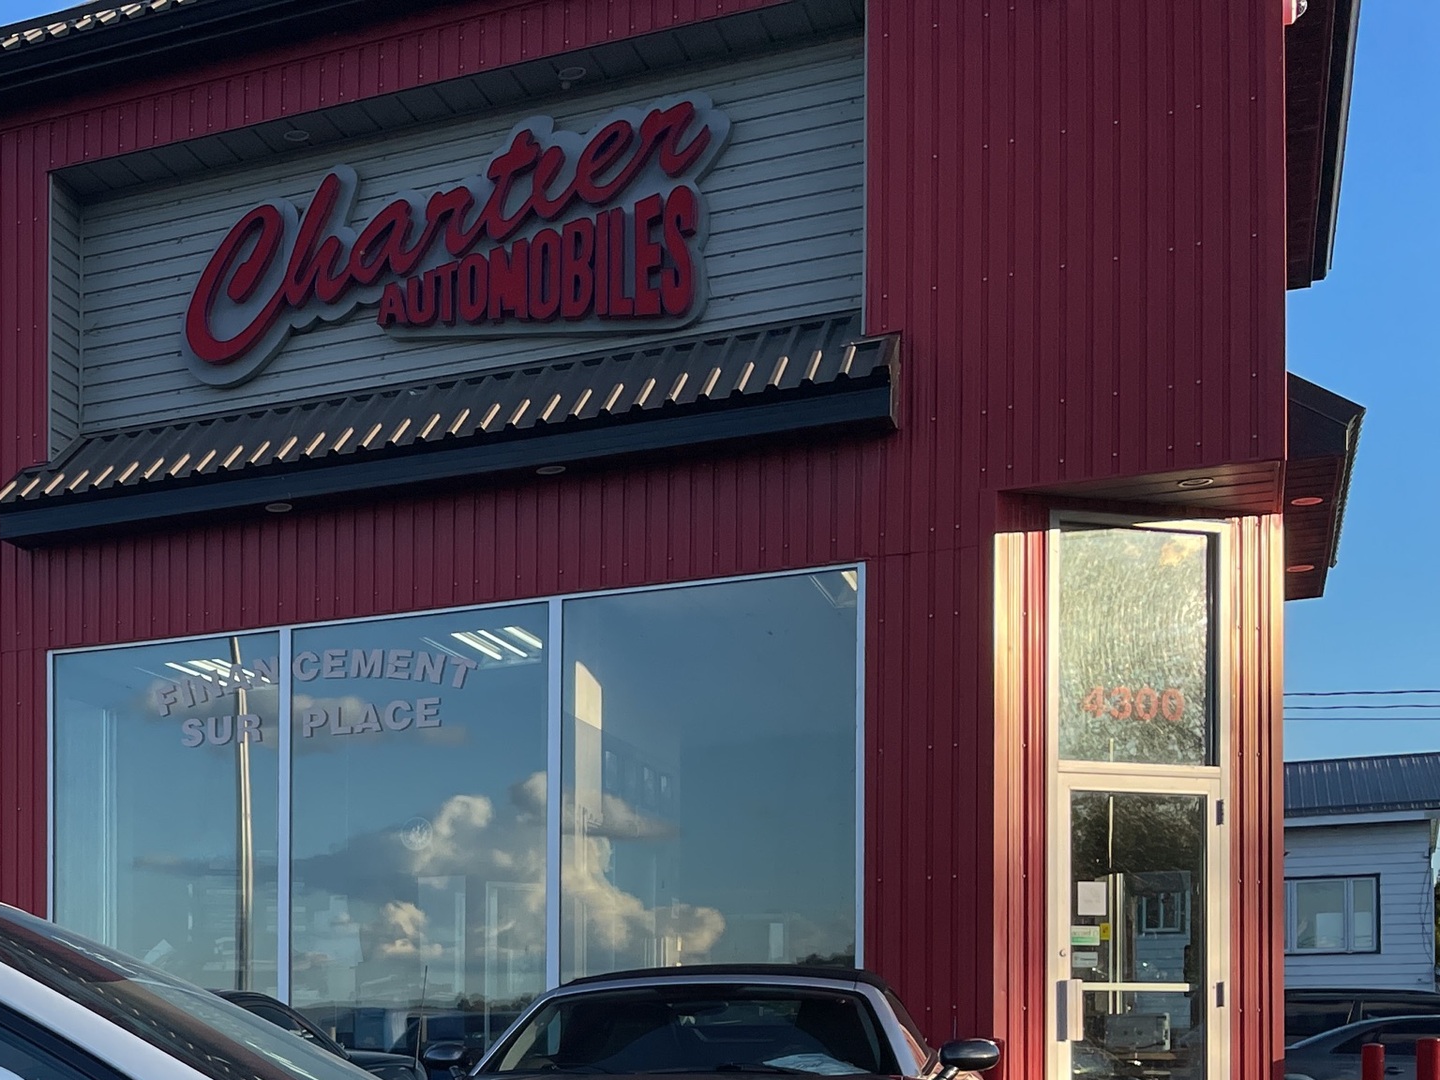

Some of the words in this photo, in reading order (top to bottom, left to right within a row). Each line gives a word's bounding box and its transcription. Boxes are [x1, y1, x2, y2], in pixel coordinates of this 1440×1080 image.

[186, 100, 711, 366] Chartier
[376, 185, 698, 326] AUTOMOBILES
[160, 649, 478, 716] FINANCEMENT
[1082, 685, 1186, 721] 4300
[181, 714, 262, 747] SUR
[302, 697, 442, 738] PLACE
